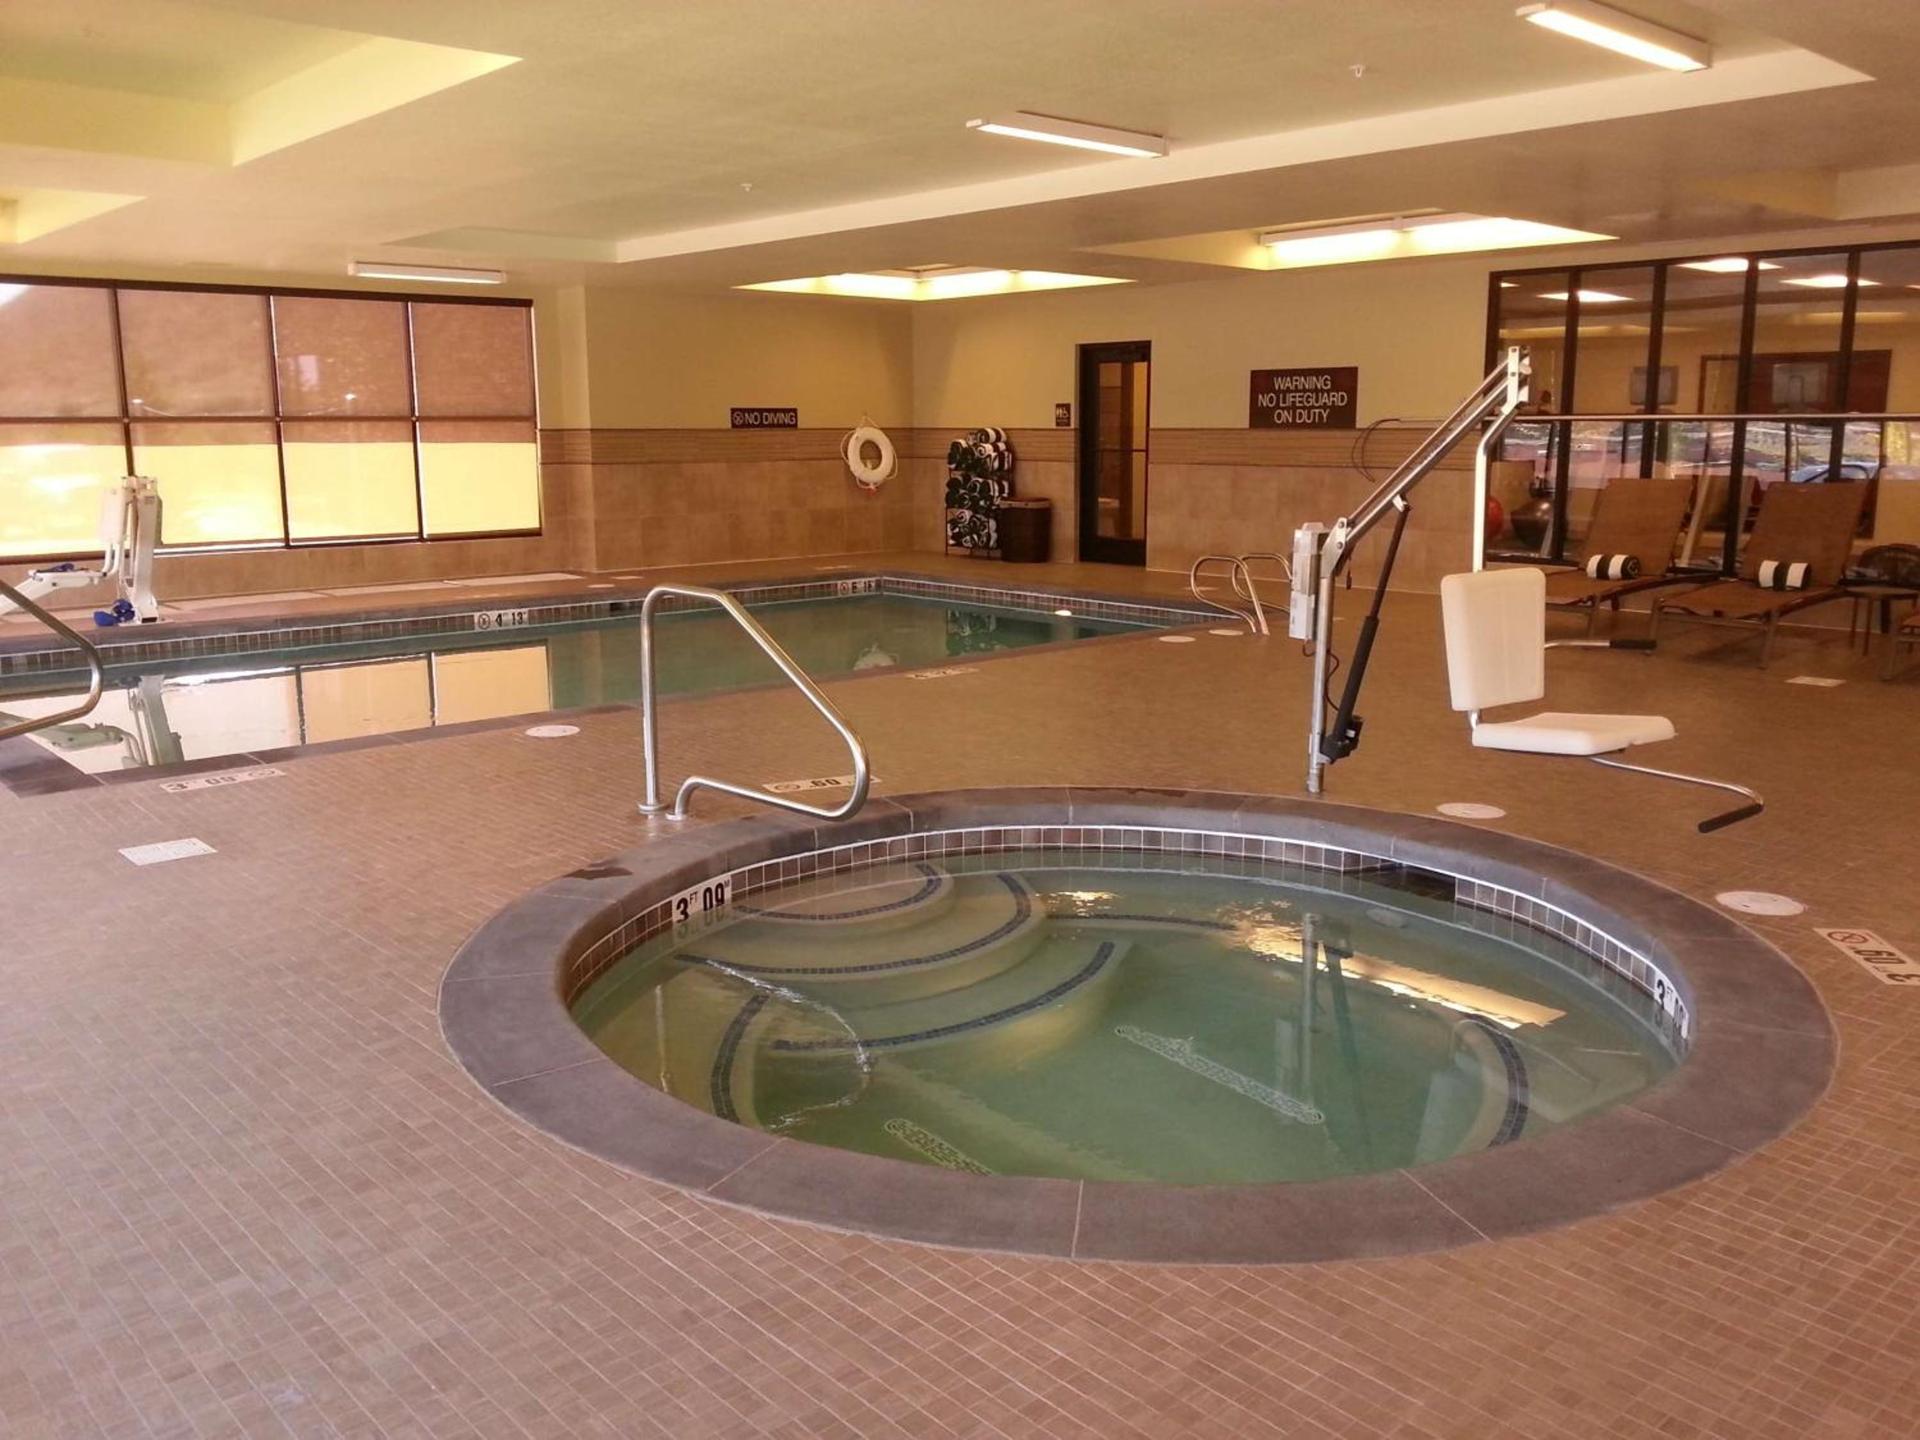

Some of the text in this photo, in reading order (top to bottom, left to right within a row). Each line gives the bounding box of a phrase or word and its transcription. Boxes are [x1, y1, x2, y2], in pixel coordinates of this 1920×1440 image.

[1273, 375, 1331, 390] WARNING
[1258, 392, 1348, 407] NO LIFEGUARD
[744, 412, 797, 425] NO DIVING
[1274, 409, 1330, 424] ON DUTY
[676, 897, 689, 923] 3
